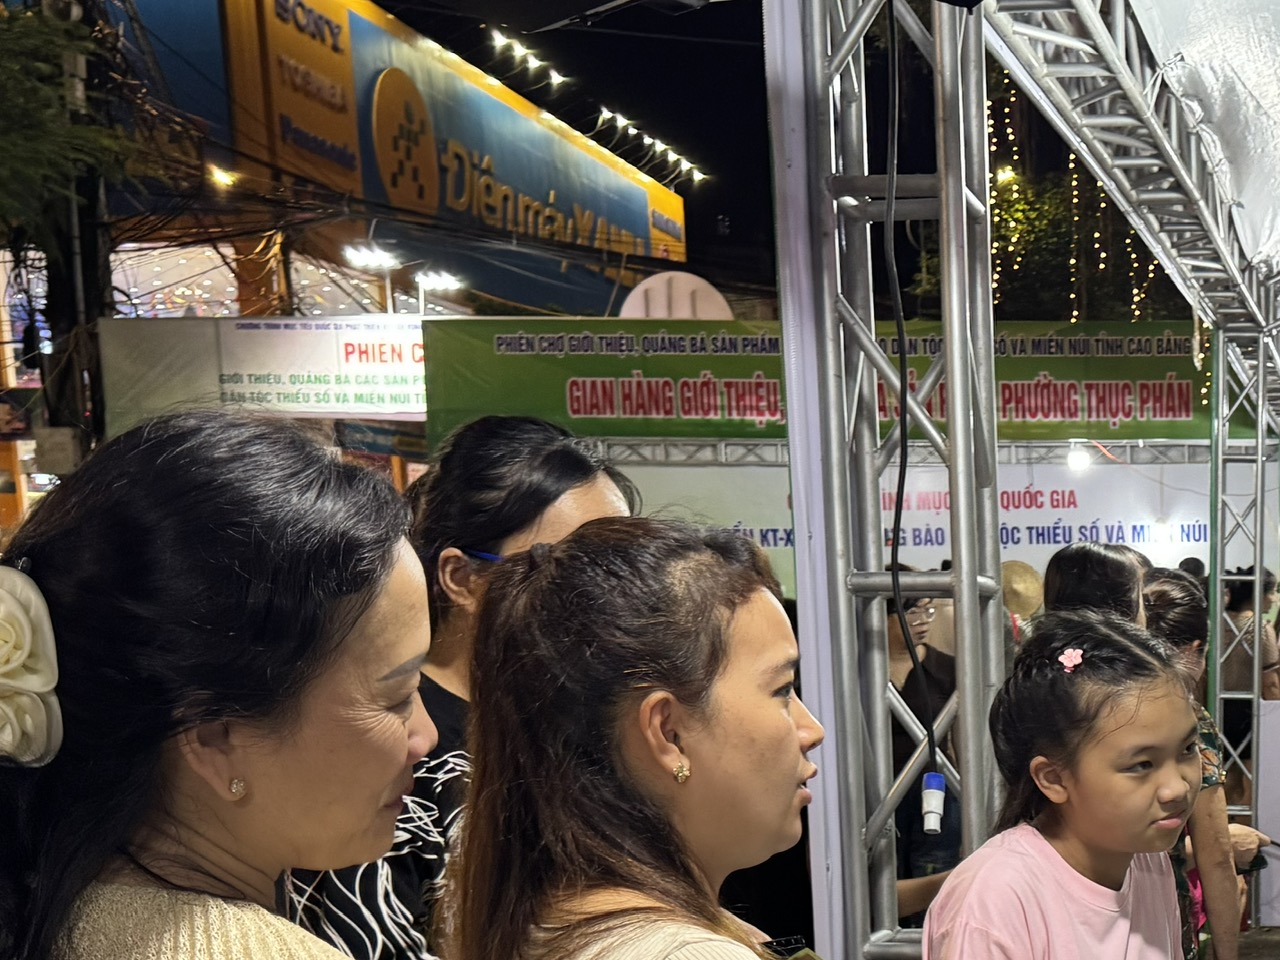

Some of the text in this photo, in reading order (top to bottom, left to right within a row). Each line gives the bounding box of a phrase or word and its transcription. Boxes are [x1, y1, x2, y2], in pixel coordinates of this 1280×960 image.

[441, 138, 514, 231] Điện
[642, 330, 687, 354] QUẢNG
[690, 331, 708, 354] BÁ
[711, 330, 738, 354] SẢN
[1127, 337, 1151, 355] CAO
[568, 378, 616, 418] GIAN
[620, 370, 675, 418] HÀNG
[680, 370, 720, 418] GIỚI
[1000, 371, 1080, 420] PHƯỜNG
[1084, 380, 1134, 428] THỤC
[1138, 372, 1192, 420] PHÁN
[1000, 483, 1044, 511] QUỐC
[1050, 489, 1078, 510] GIA
[760, 527, 794, 548] KT-X
[1000, 522, 1021, 549] ỘC
[1026, 518, 1072, 544] THIỂU
[1078, 518, 1100, 543] SỐ
[1105, 521, 1126, 543] VÀ
[1181, 519, 1208, 543] NÚI
